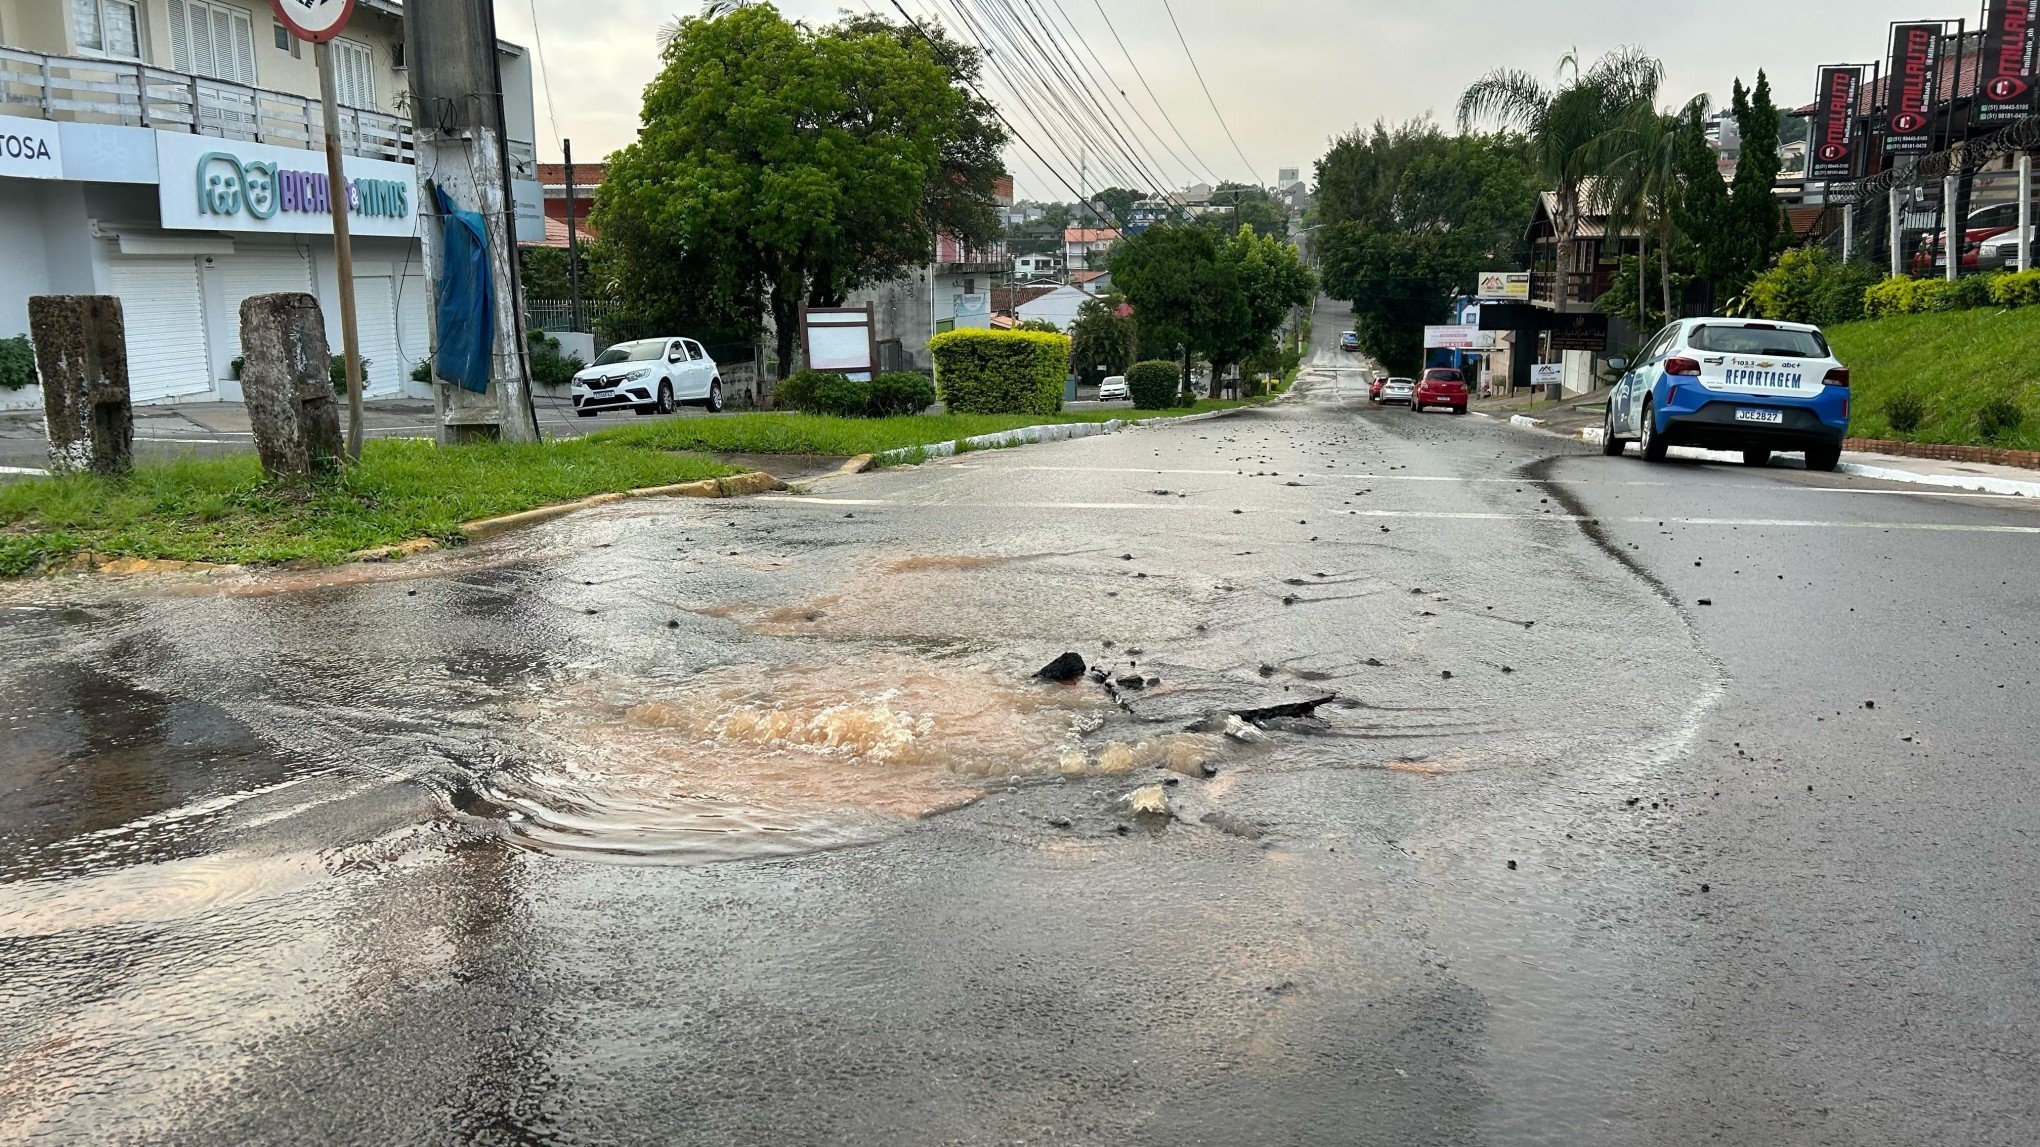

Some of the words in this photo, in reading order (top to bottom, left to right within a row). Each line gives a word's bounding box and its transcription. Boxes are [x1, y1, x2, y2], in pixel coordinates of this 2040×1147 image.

[2024, 28, 2035, 68] millauto_nh
[1901, 29, 1929, 112] MILLAUTO
[1923, 71, 1933, 106] millauto_nh
[1827, 72, 1850, 143] MILLAUTO
[0, 134, 51, 160] TOSA
[278, 169, 351, 214] BICH
[355, 177, 409, 218] MIMOS
[1725, 369, 1802, 389] REPORTAGEM
[1739, 410, 1778, 422] JCE2B27
